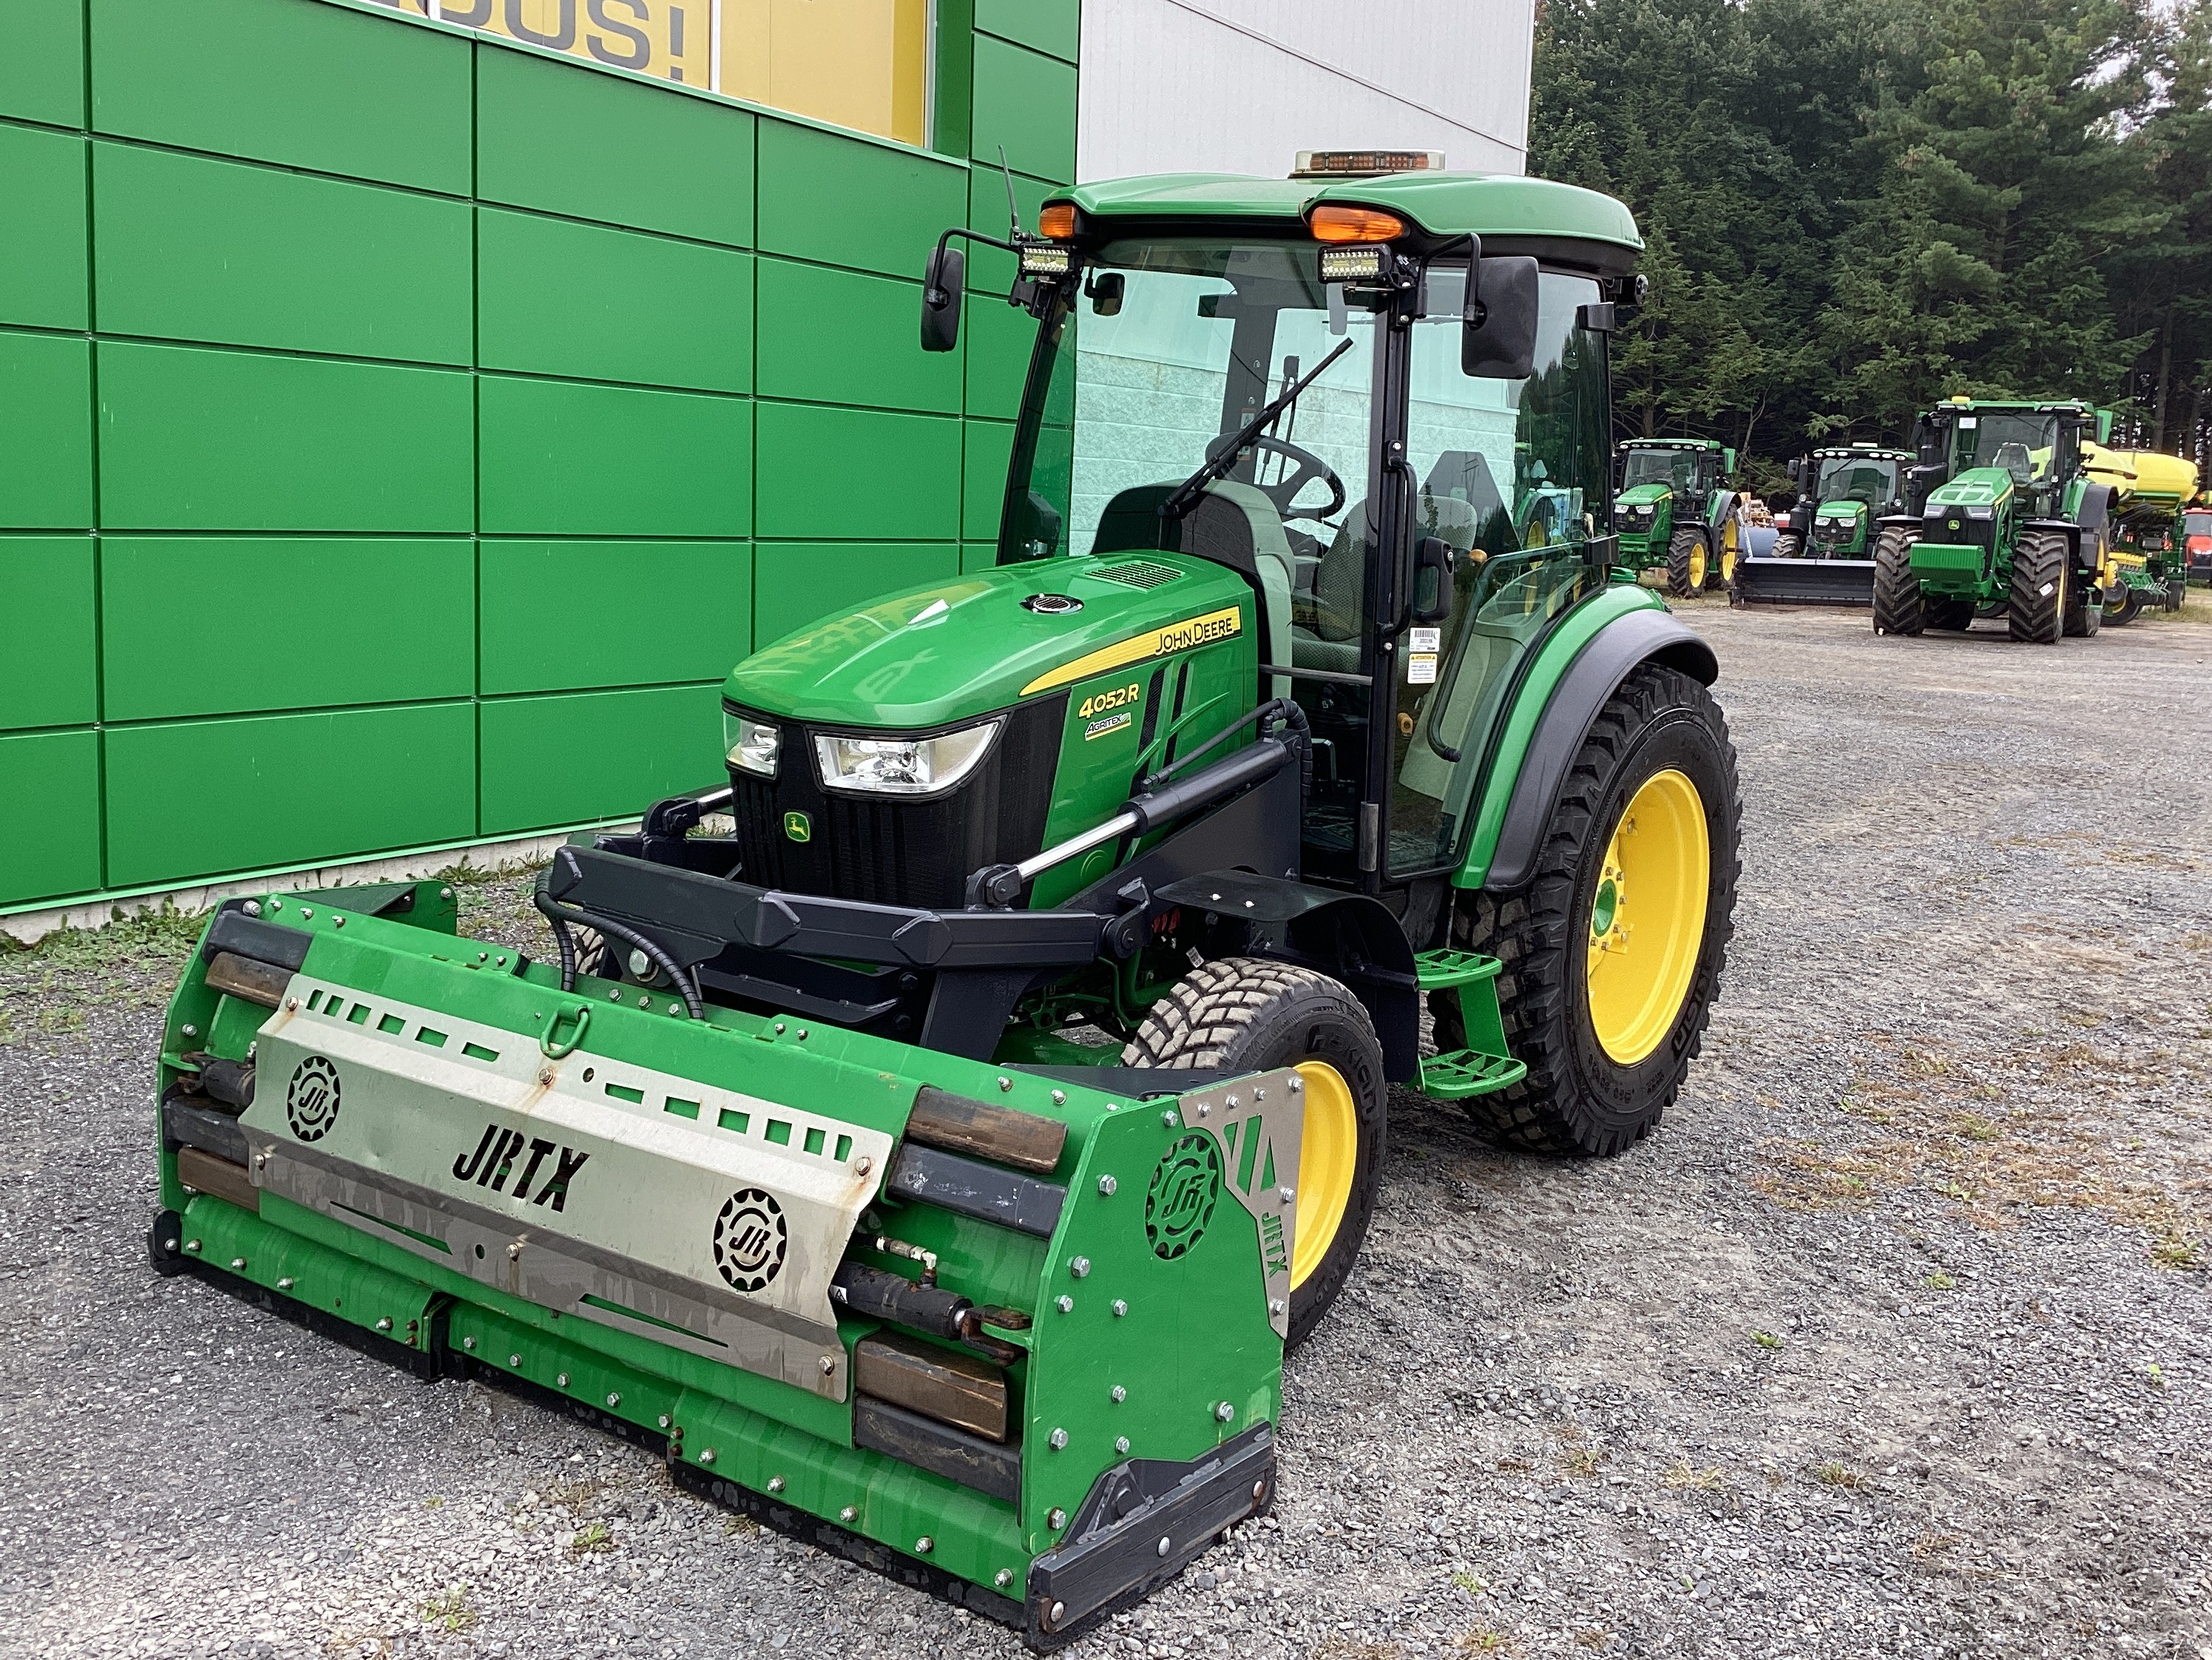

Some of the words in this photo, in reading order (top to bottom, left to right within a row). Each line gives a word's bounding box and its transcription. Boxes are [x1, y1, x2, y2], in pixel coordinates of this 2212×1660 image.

[1155, 628, 1192, 653] JOHN
[1194, 617, 1233, 641] DEERE
[452, 1122, 590, 1213] JRTX
[1261, 1211, 1288, 1279] JRTX
